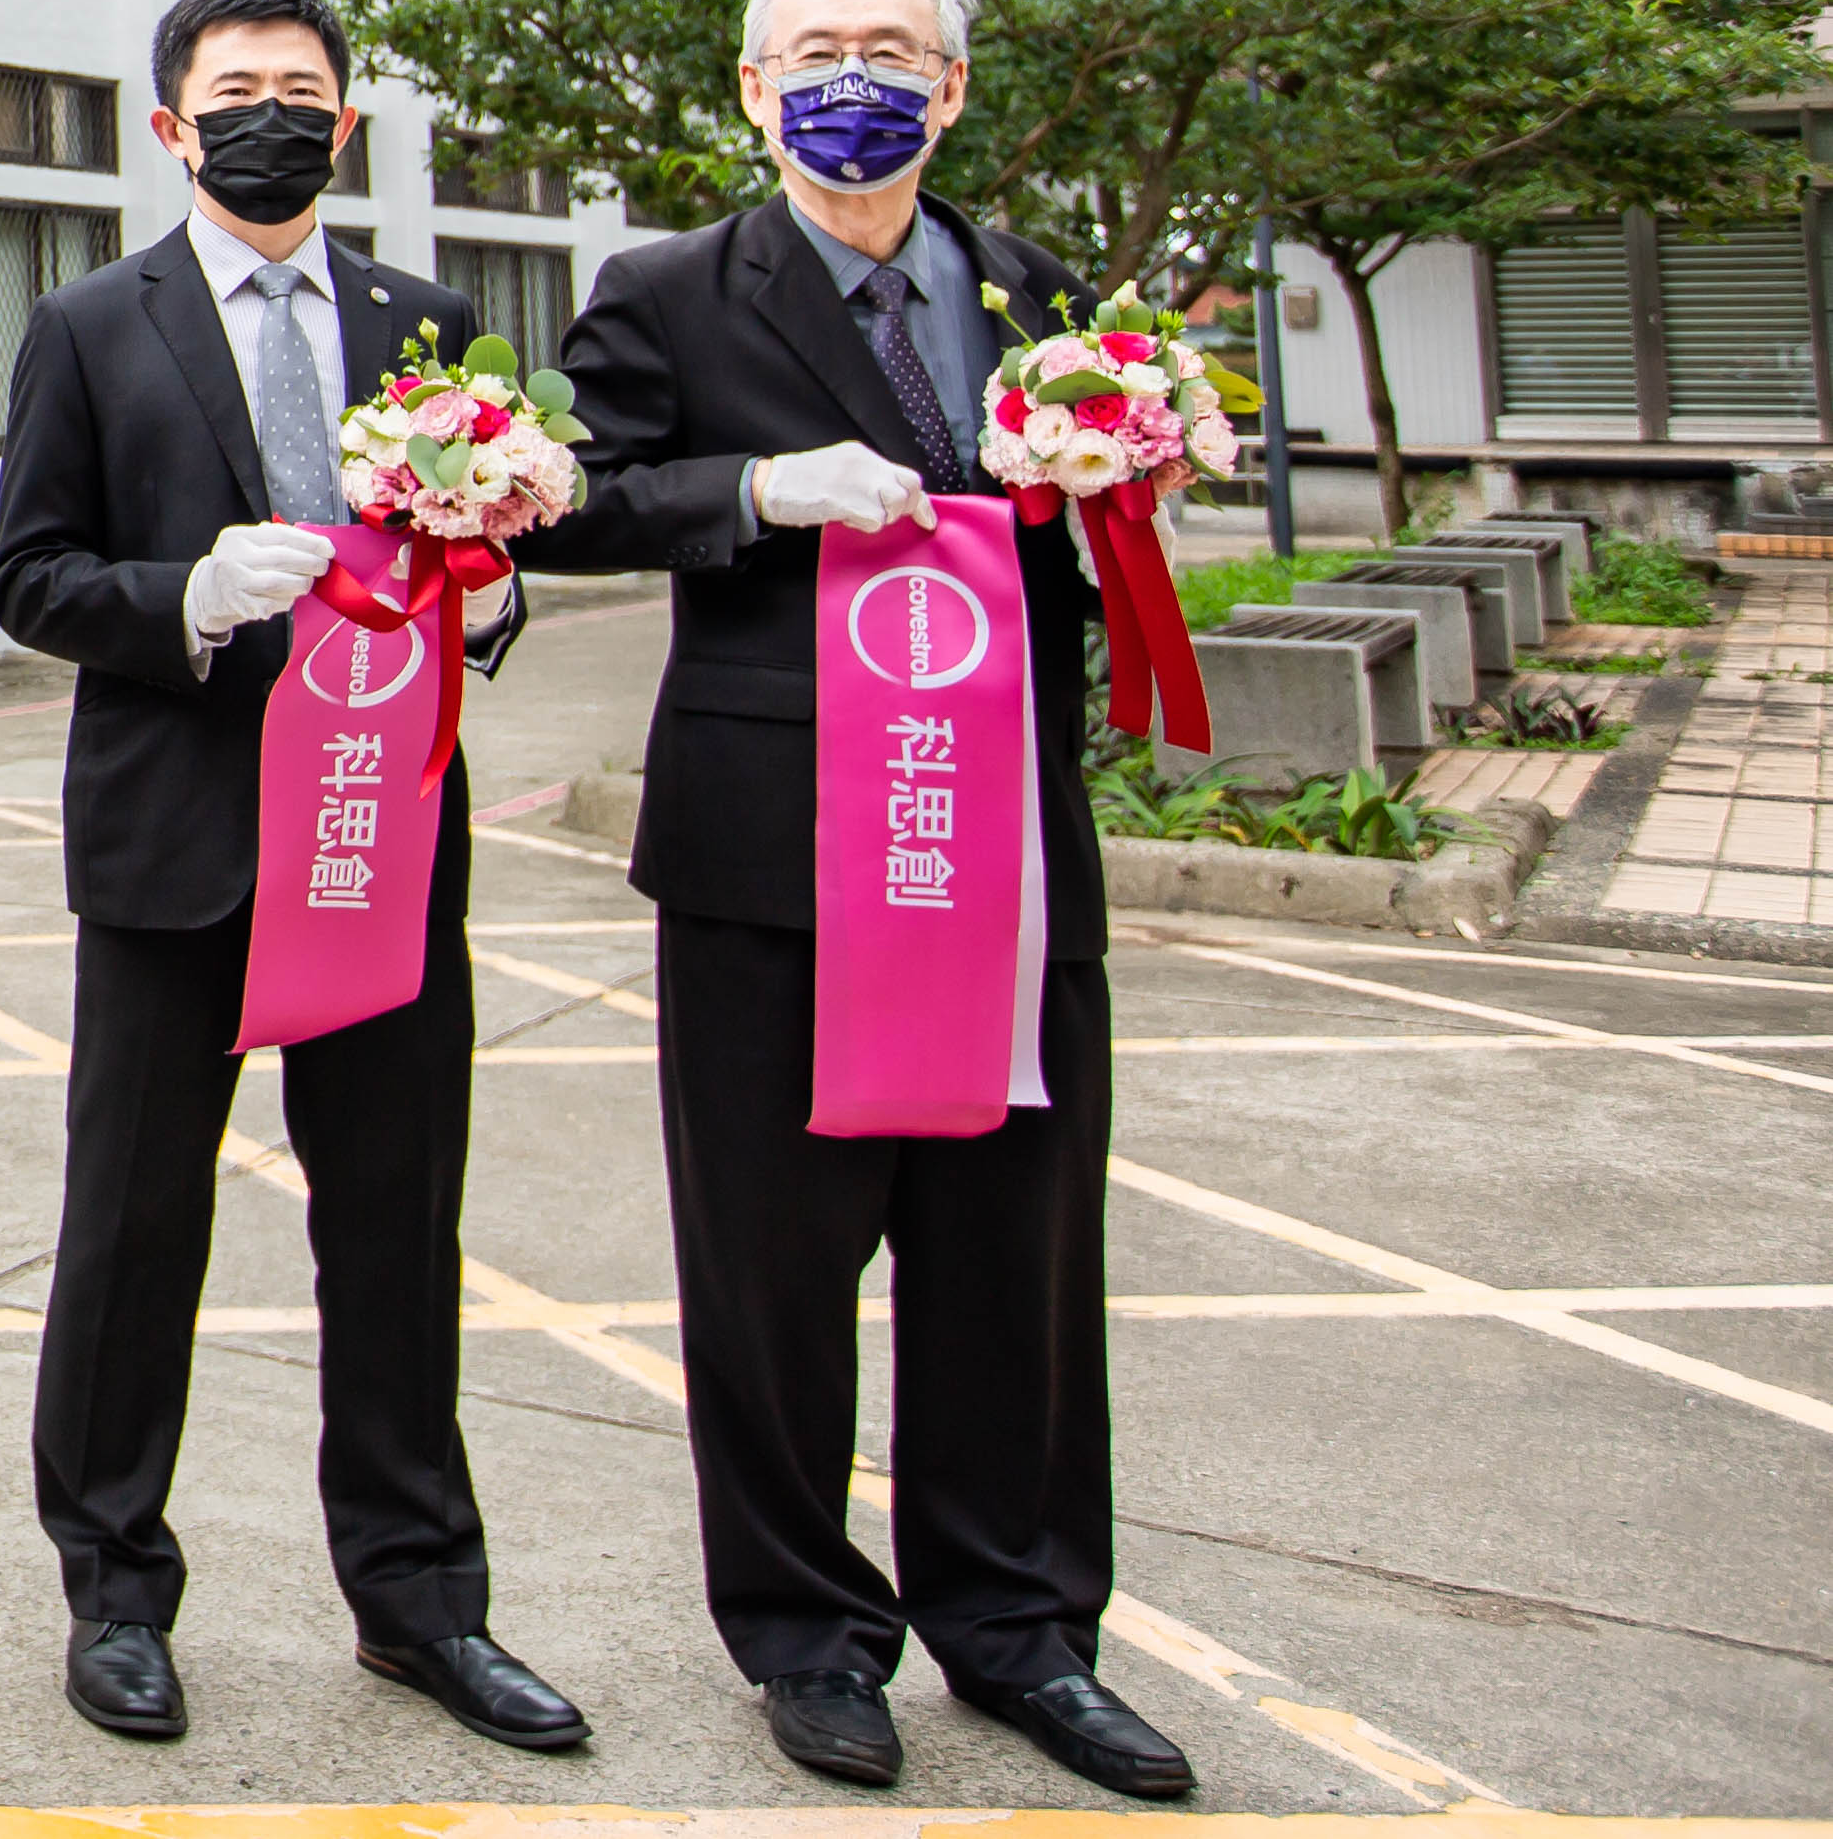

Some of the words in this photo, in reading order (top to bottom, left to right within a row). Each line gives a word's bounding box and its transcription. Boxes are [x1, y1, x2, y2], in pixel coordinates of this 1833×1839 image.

[347, 625, 371, 694] vestro
[908, 575, 930, 675] covestro
[307, 732, 383, 910] 科思創
[885, 713, 957, 910] 科思創
